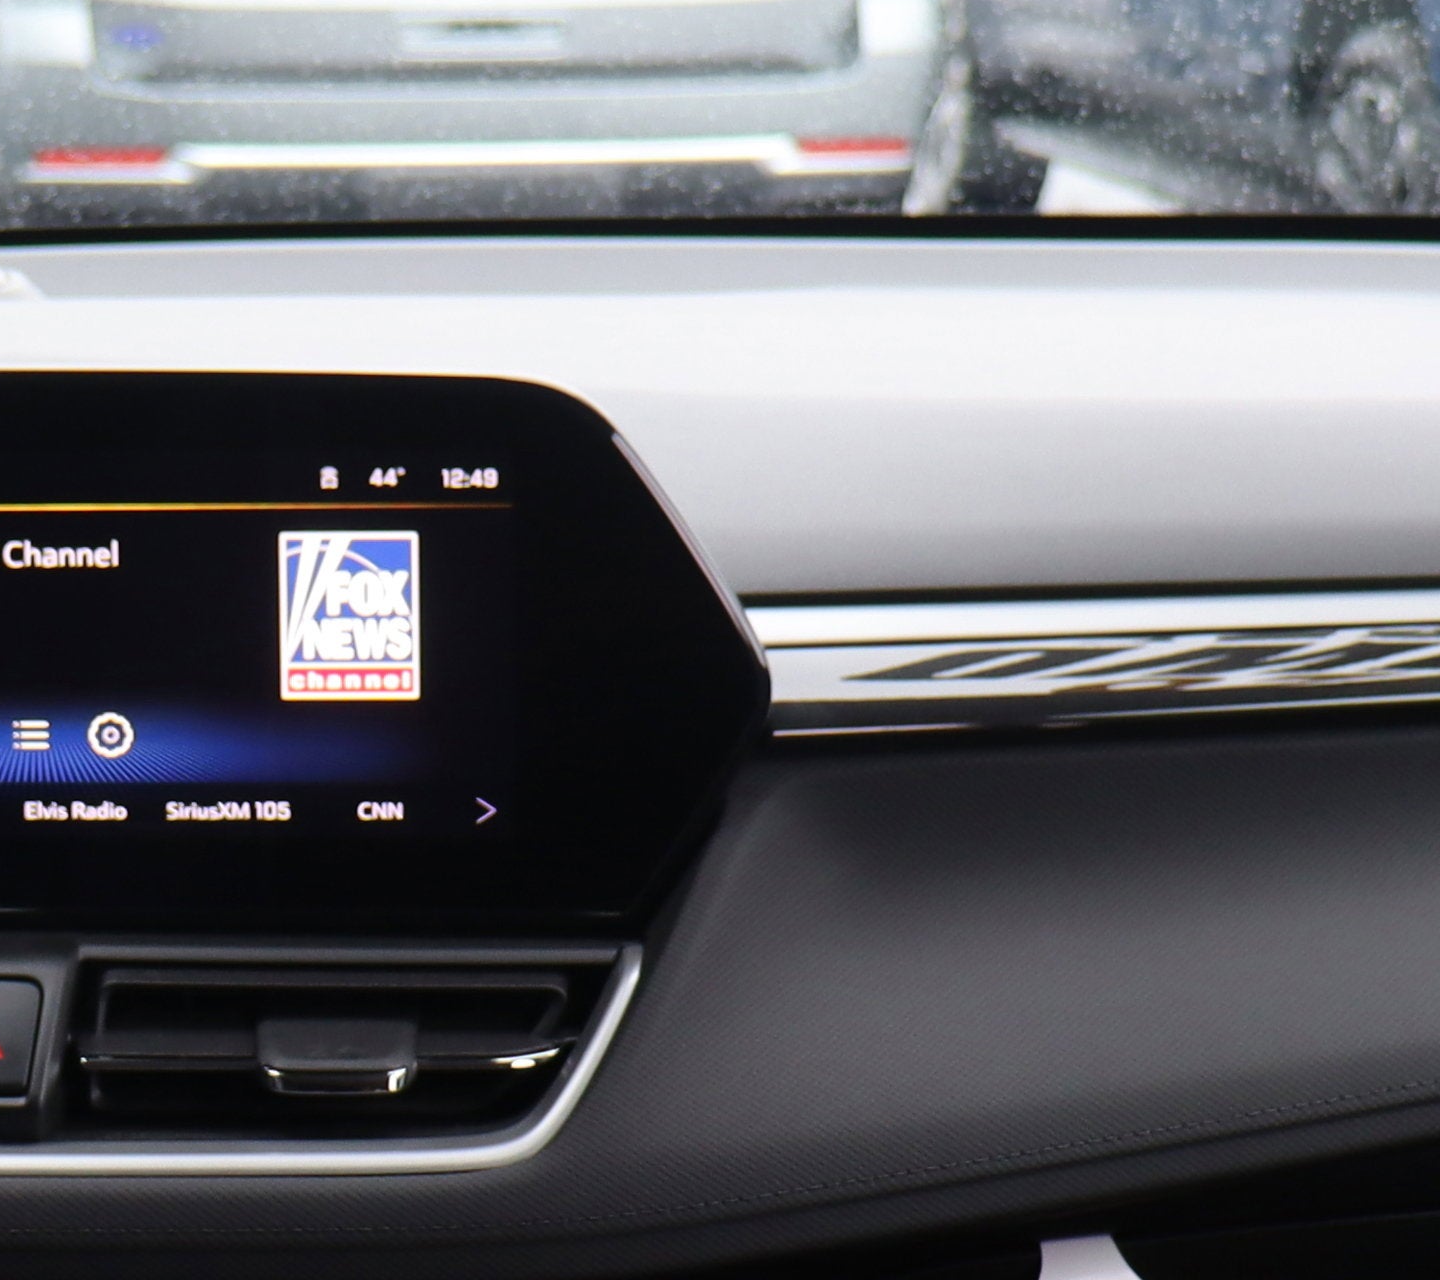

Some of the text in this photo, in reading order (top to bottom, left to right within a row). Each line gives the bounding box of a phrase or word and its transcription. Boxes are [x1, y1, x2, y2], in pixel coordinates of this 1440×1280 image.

[369, 466, 499, 489] 44° 12:49
[2, 539, 120, 570] Channel
[325, 570, 411, 618] FOX
[301, 617, 413, 662] NEWS
[288, 670, 412, 692] channel
[24, 800, 128, 820] Elvis Radio
[165, 801, 291, 820] SiriusXM 105
[357, 801, 404, 820] CNN
